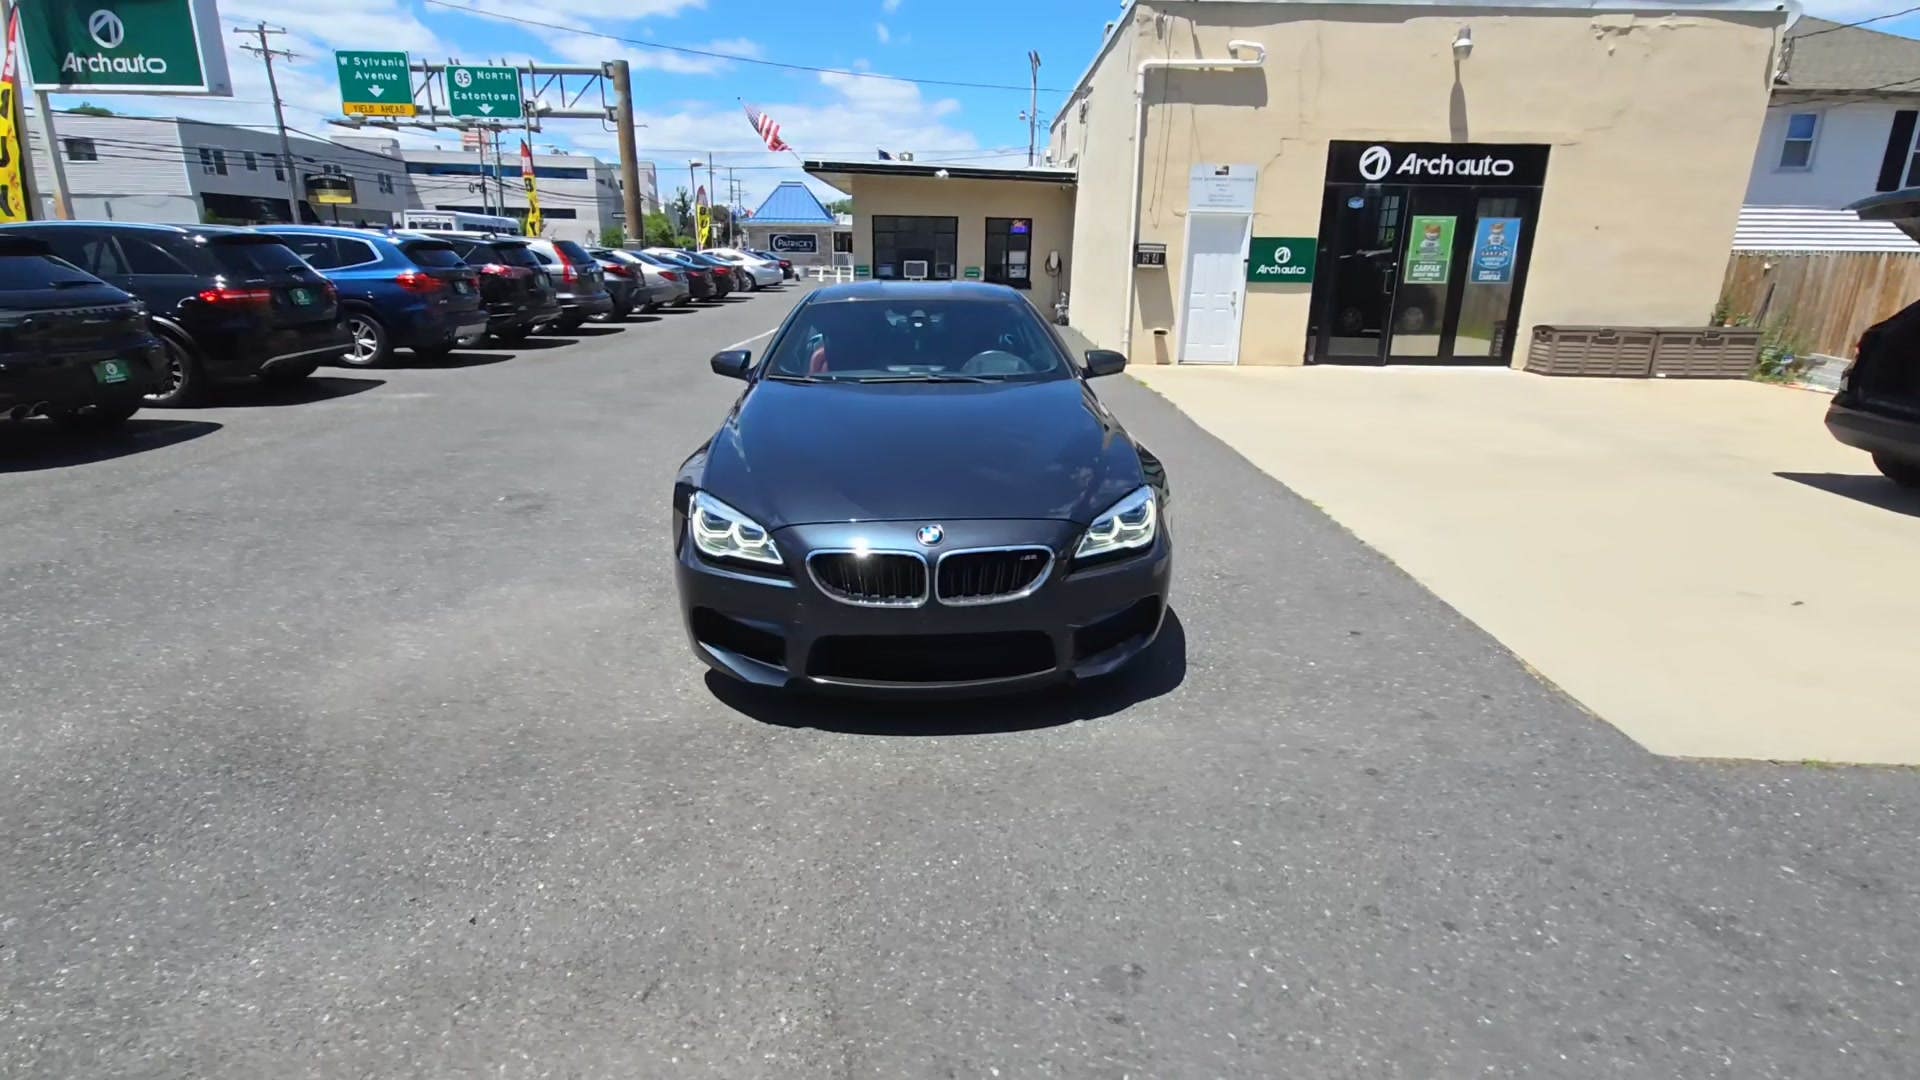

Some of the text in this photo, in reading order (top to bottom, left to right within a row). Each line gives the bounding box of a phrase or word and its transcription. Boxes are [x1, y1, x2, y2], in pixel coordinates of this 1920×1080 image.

[61, 52, 167, 74] Archauto
[339, 56, 405, 68] W Sylvania
[354, 70, 398, 81] Avenue
[456, 72, 470, 84] 35
[453, 91, 516, 101] Eatontown
[352, 105, 406, 114] YIELD AHEAD
[1396, 153, 1514, 176] Archauto
[1256, 264, 1306, 275] Archauto
